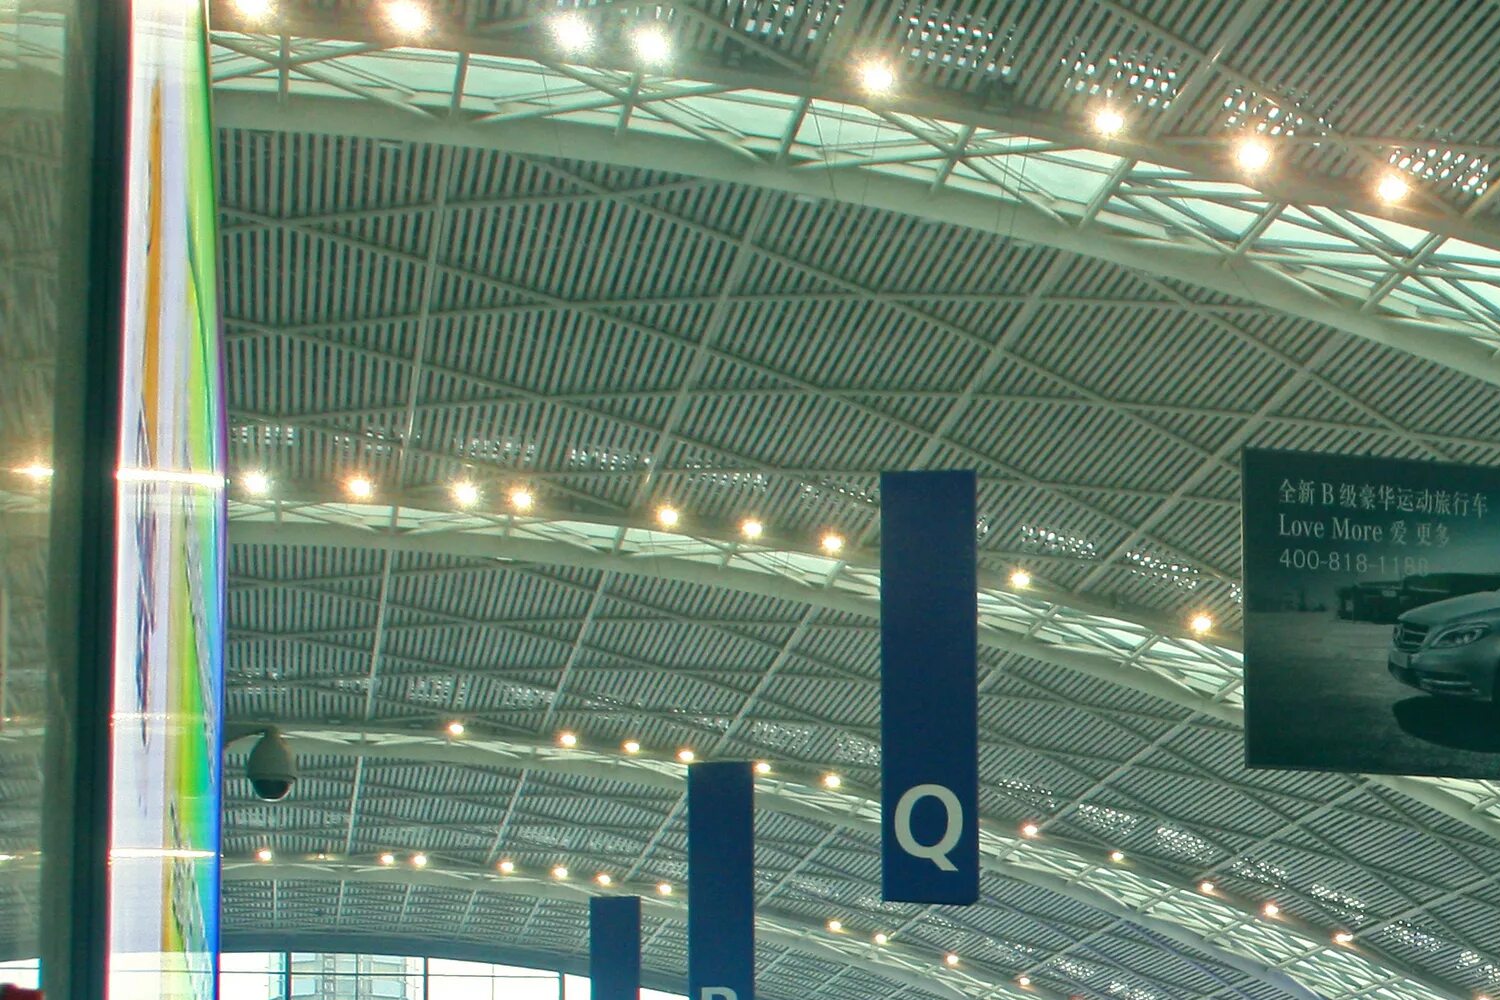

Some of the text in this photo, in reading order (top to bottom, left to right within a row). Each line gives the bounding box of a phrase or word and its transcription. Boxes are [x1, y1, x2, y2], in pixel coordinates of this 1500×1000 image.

[1279, 512, 1325, 539] Love
[1332, 516, 1384, 543] More
[894, 783, 964, 873] Q
